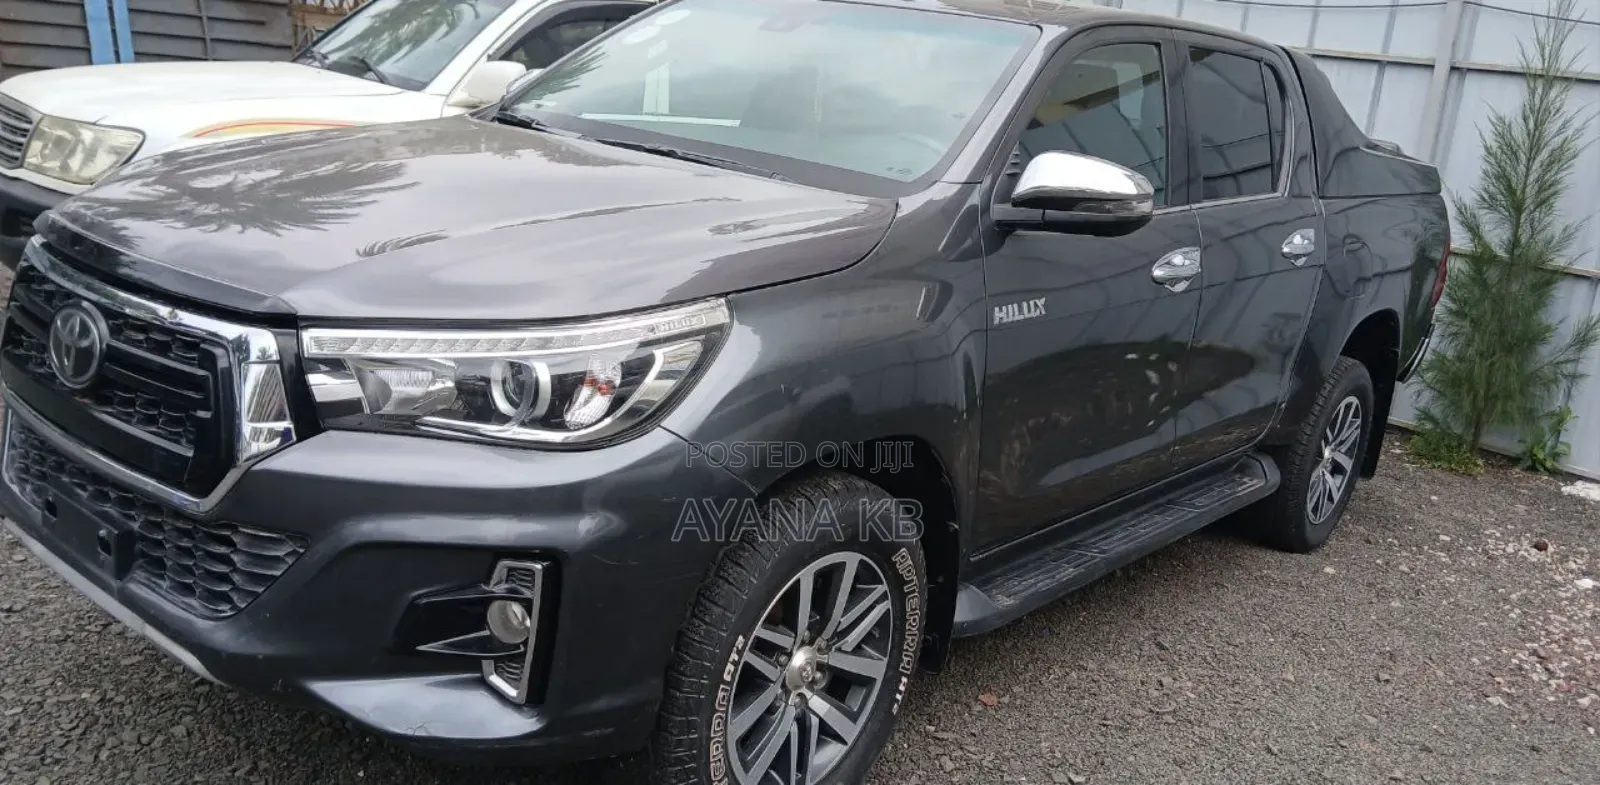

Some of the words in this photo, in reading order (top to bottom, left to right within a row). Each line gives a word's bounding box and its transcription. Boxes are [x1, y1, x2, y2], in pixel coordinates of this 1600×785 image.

[658, 316, 700, 332] HILUX
[994, 297, 1046, 325] HILUX
[891, 547, 921, 675] APTERRA
